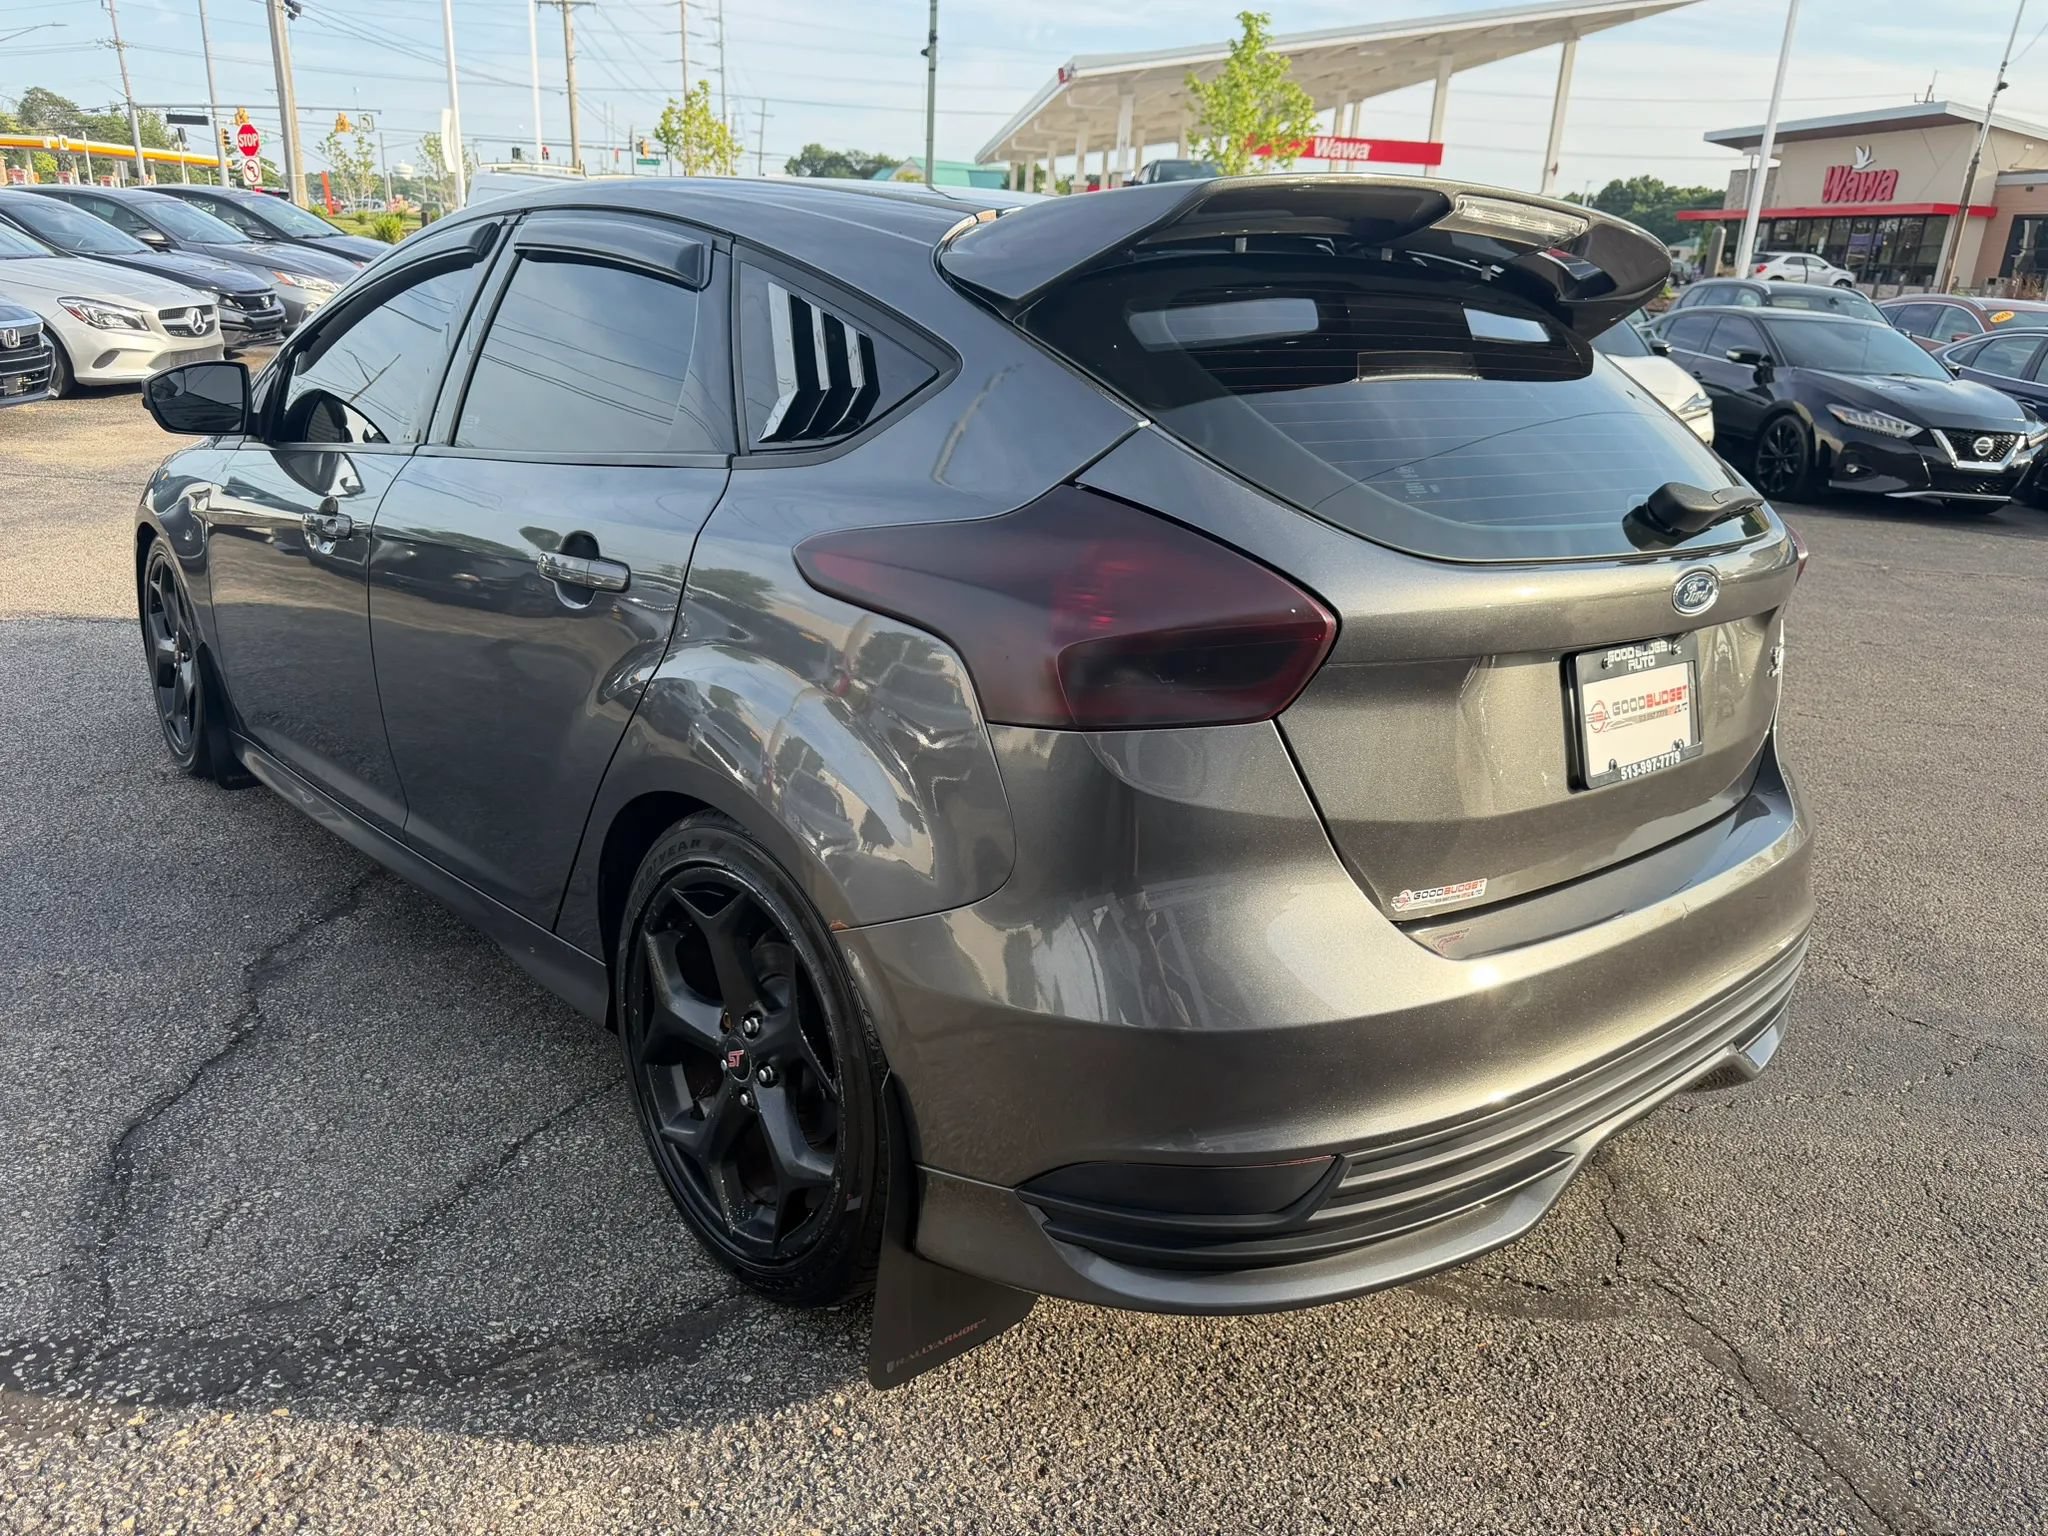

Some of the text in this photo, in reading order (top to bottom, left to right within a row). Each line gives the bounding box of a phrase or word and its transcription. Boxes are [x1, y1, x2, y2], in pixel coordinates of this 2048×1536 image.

[238, 133, 258, 148] STOP
[1314, 138, 1371, 160] Wawa
[1823, 166, 1898, 203] Wawa
[1684, 581, 1712, 605] Ford
[1627, 655, 1656, 671] AUTO
[728, 1049, 745, 1068] ST
